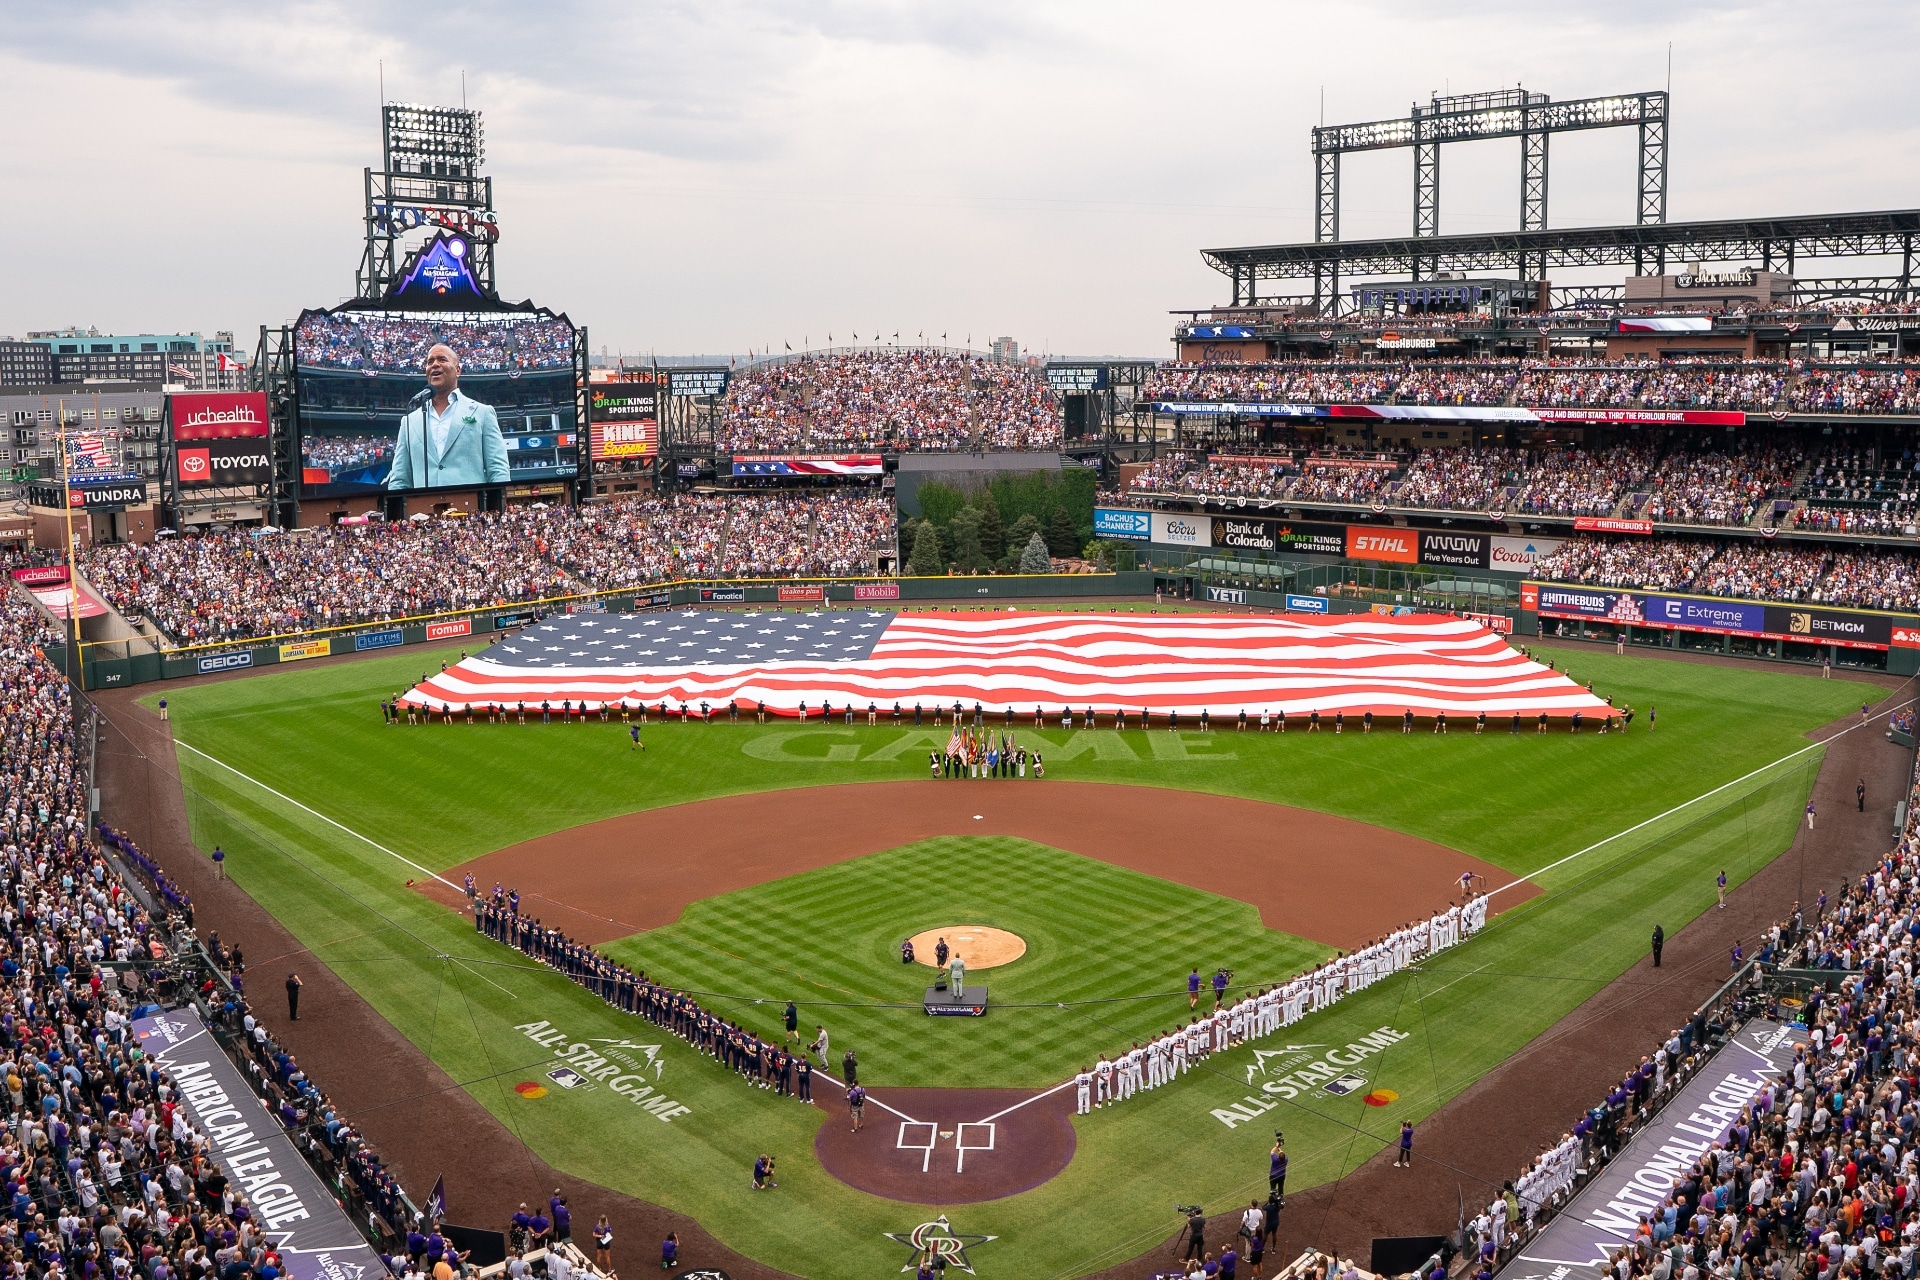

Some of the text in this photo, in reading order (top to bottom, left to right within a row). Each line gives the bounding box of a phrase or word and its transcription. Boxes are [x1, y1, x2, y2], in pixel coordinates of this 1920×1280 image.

[373, 204, 500, 242] ROCKIES
[1695, 271, 1717, 283] JACK
[1352, 286, 1482, 308] THE ROOFTOP
[1856, 318, 1899, 331] Silver
[1203, 345, 1242, 361] Coors
[594, 397, 654, 409] DRAFTKINGS
[608, 405, 654, 414] SPORTSBOOK
[1272, 405, 1281, 413] THE
[1302, 406, 1317, 414] FIGHT,
[187, 405, 255, 424] uchealth
[1555, 411, 1567, 420] AND
[1567, 411, 1587, 420] BRIGHT
[1587, 412, 1608, 421] STARS,
[1625, 412, 1637, 421] THE
[1637, 412, 1666, 422] PERILOUS
[1666, 413, 1685, 422] FIGHT,
[603, 425, 646, 442] KING
[603, 441, 647, 458] Soopers
[211, 455, 269, 469] TOYOTA
[678, 464, 697, 472] PLATTE
[83, 488, 142, 502] TUNDRA
[1104, 513, 1134, 523] BACHUS
[1095, 520, 1134, 531] SCHANKER
[1166, 520, 1197, 535] Coors
[1226, 521, 1264, 535] Bank of
[1597, 520, 1644, 531] #HITTHEBUDS
[1225, 533, 1274, 548] Colorado
[1280, 533, 1342, 545] DRAFTKINGS
[1355, 536, 1409, 553] STIHL
[1294, 542, 1341, 552] SPORTSBOOK
[1424, 552, 1480, 565] Five Years Out
[1492, 547, 1531, 564] Coors
[20, 568, 61, 581] uchealth
[712, 592, 743, 600] Fanatics
[866, 588, 896, 597] Mobile
[1210, 588, 1243, 603] YETI
[1291, 599, 1323, 609] GEICO
[1541, 592, 1605, 608] #HITTHEBUDS
[1687, 605, 1743, 621] Extreme
[505, 617, 532, 627] SPORTSNET
[1712, 620, 1742, 628] networks
[1812, 619, 1865, 634] BETMGM
[431, 623, 465, 636] roman
[367, 633, 401, 643] LIFETIME
[282, 649, 305, 658] LOUISIANA
[200, 653, 251, 670] GEICO
[105, 674, 122, 683] 347
[741, 728, 1240, 762] GAME
[602, 1048, 642, 1071] COLORADO
[1262, 1061, 1345, 1100] STAR
[1325, 1025, 1411, 1066] GAME
[1269, 1053, 1314, 1076] COLORADO
[1352, 1067, 1370, 1077] 21
[553, 1042, 622, 1082] STAR
[608, 1075, 692, 1123] GAME
[1310, 1089, 1329, 1099] 20
[169, 1061, 311, 1231] AMERICAN LEAGUE
[1582, 1073, 1764, 1238] NATIONAL LEAGUE
